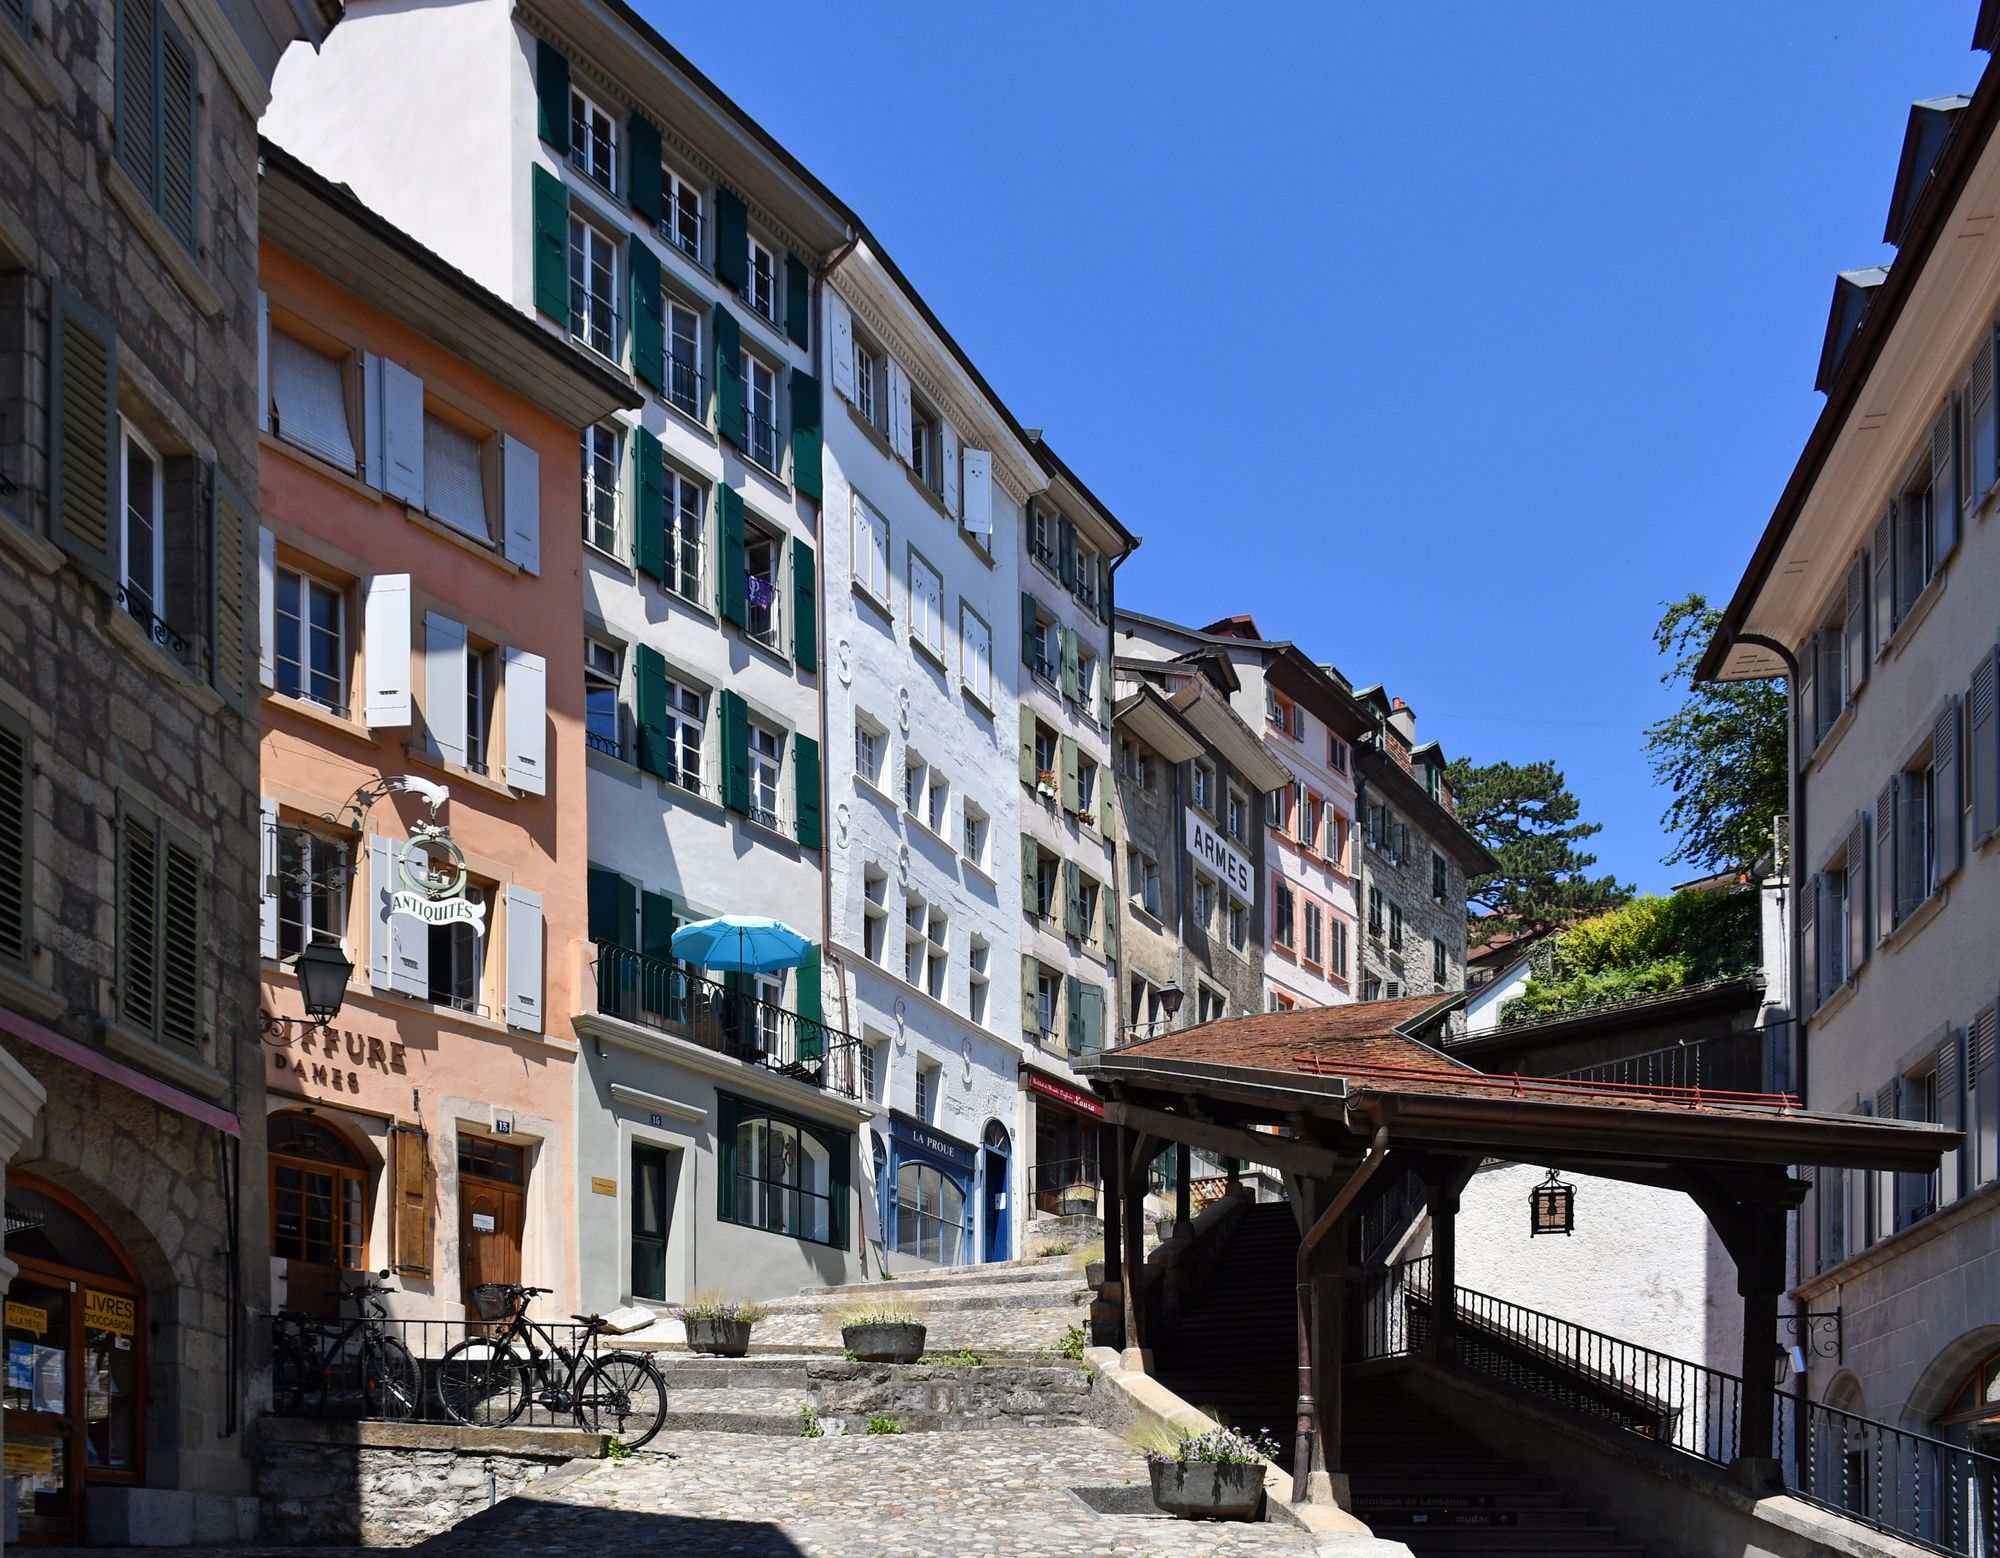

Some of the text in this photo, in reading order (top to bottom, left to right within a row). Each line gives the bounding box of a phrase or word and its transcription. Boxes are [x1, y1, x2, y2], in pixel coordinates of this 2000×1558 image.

[1194, 824, 1247, 892] ARMES
[391, 895, 473, 922] ANTIQUITÉS
[274, 1052, 358, 1089] DAMES
[652, 1115, 661, 1125] 15
[912, 1130, 955, 1158] LA PROUE
[8, 1304, 45, 1319] ATTENTION
[84, 1291, 133, 1319] LIVRES
[1405, 1496, 1417, 1505] de
[1420, 1496, 1469, 1505] Lausanne
[1456, 1514, 1490, 1523] mudac
